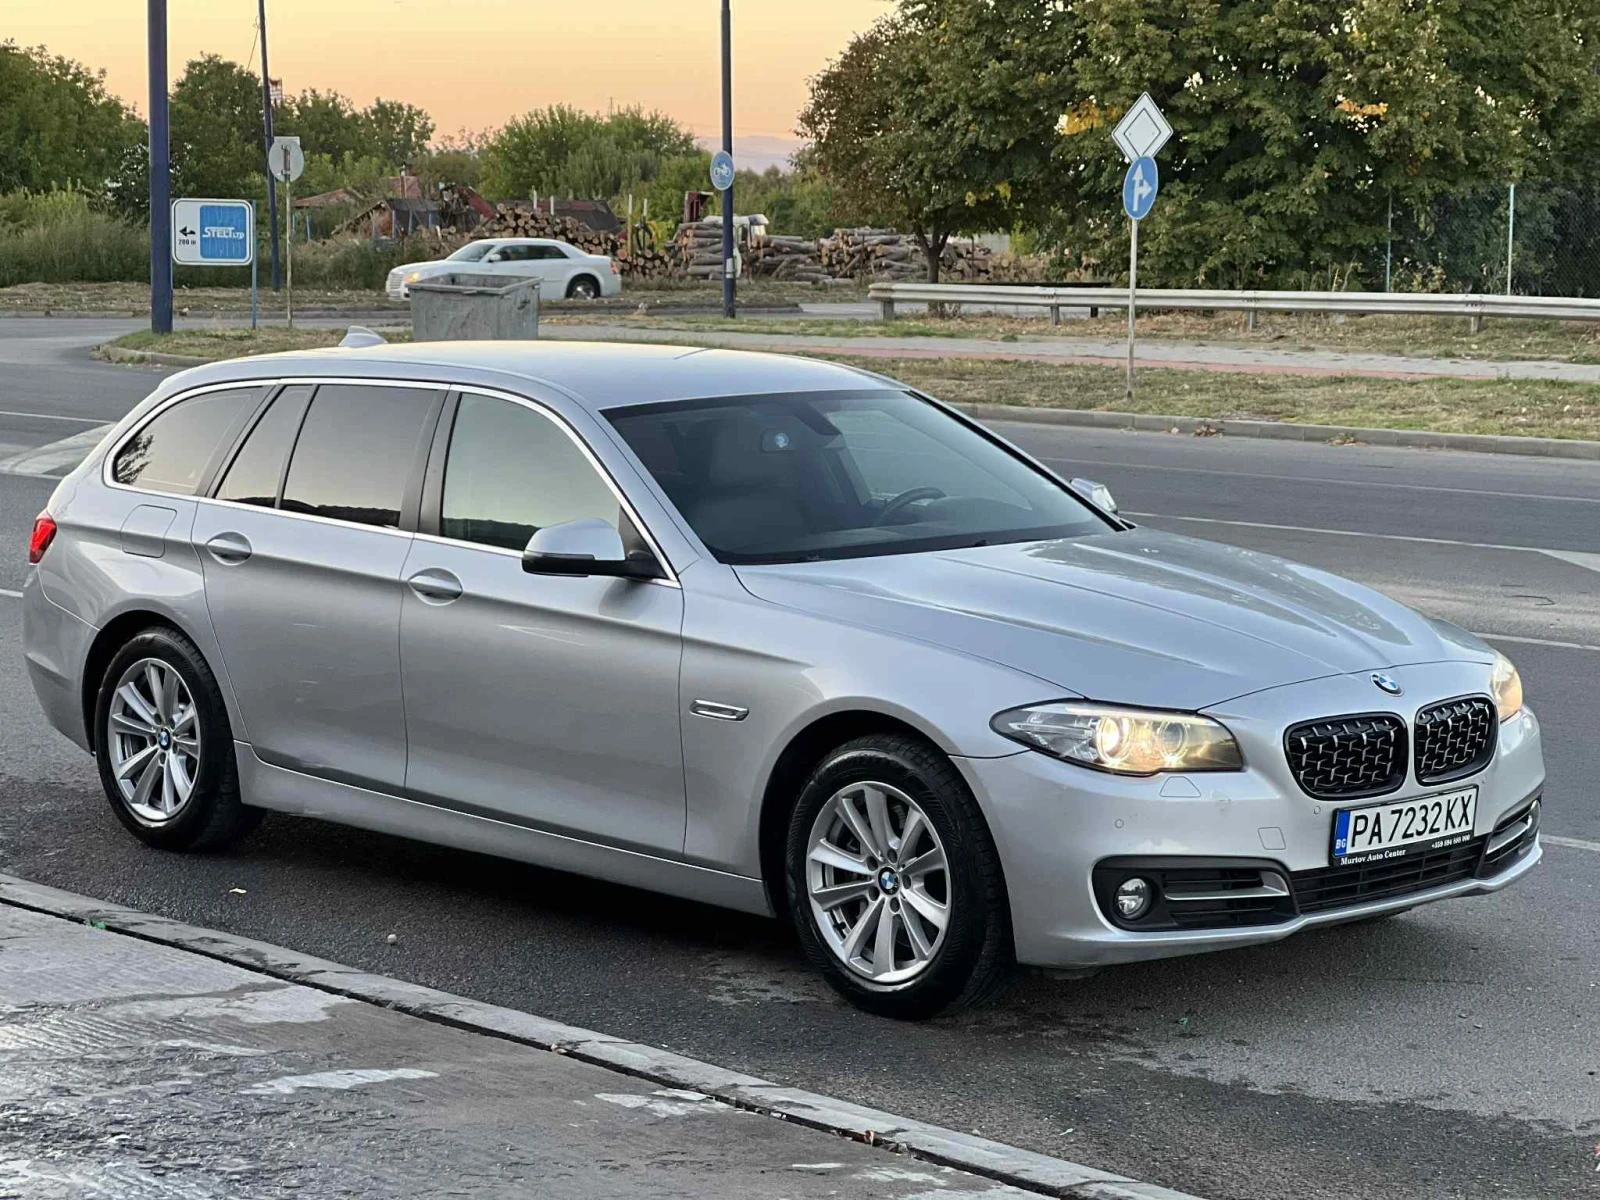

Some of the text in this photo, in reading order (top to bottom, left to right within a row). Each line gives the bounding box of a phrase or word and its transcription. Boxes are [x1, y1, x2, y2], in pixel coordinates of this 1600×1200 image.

[1335, 839, 1346, 849] BG
[1340, 849, 1406, 866] Murtov Auto Center
